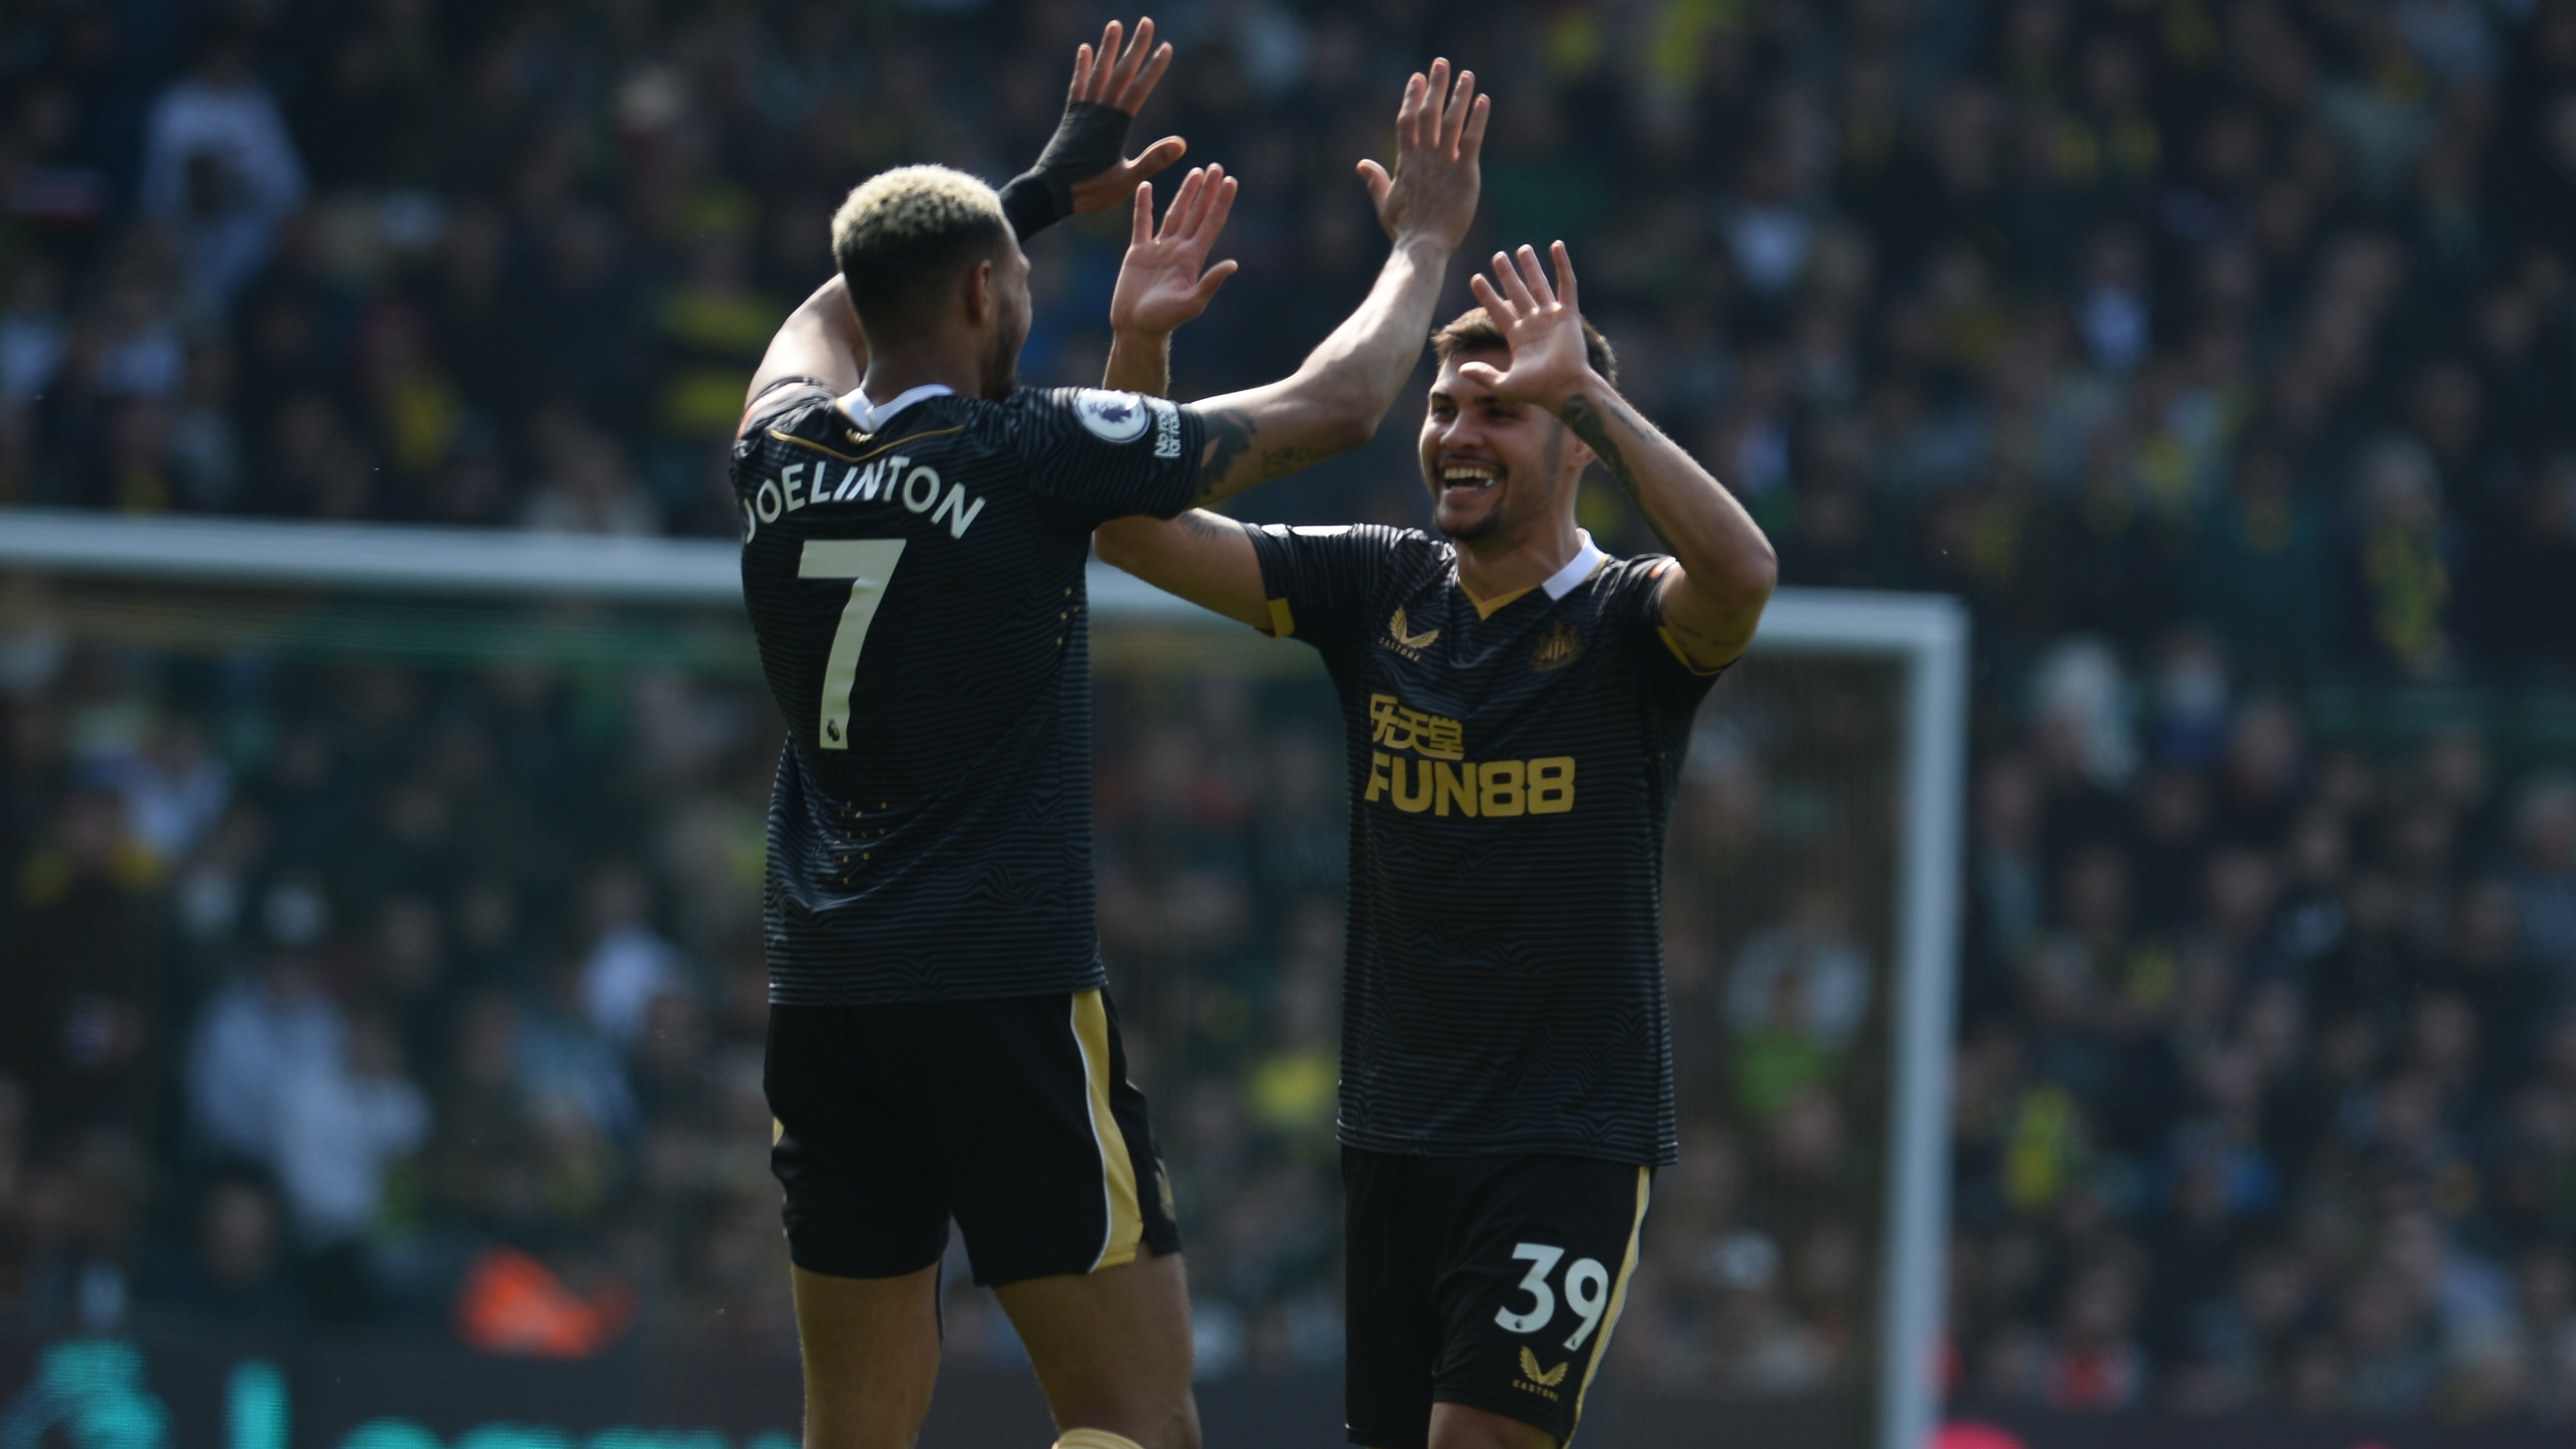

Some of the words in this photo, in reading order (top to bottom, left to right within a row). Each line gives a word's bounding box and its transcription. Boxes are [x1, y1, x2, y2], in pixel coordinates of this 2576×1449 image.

[743, 456, 985, 544] JOELINTON
[798, 539, 906, 749] 7
[1378, 636, 1420, 663] CASTORE
[1364, 749, 1575, 818] FUN88
[1494, 1242, 1609, 1352] 39
[1512, 1379, 1559, 1402] CASTORE
